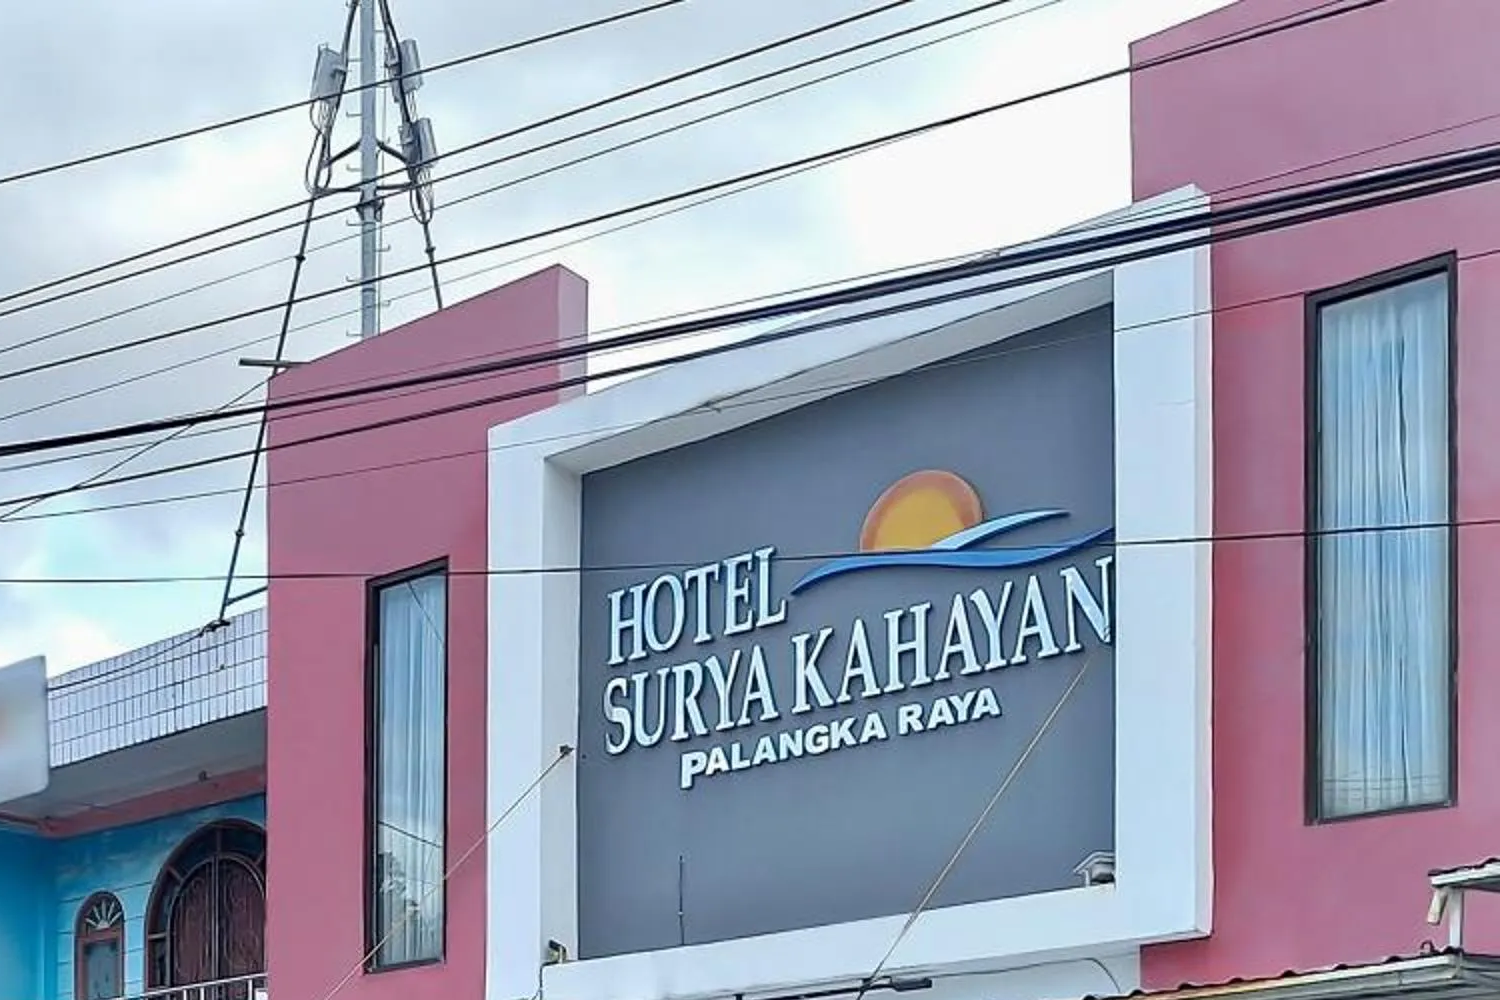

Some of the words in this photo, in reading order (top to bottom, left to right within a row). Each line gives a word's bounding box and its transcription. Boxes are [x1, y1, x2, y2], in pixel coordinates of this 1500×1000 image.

[604, 645, 778, 754] SURYA
[791, 556, 1112, 714] KAHAYAN
[607, 547, 786, 666] HOTEL
[680, 711, 887, 788] PALANGKA
[899, 687, 1000, 735] RAYA
